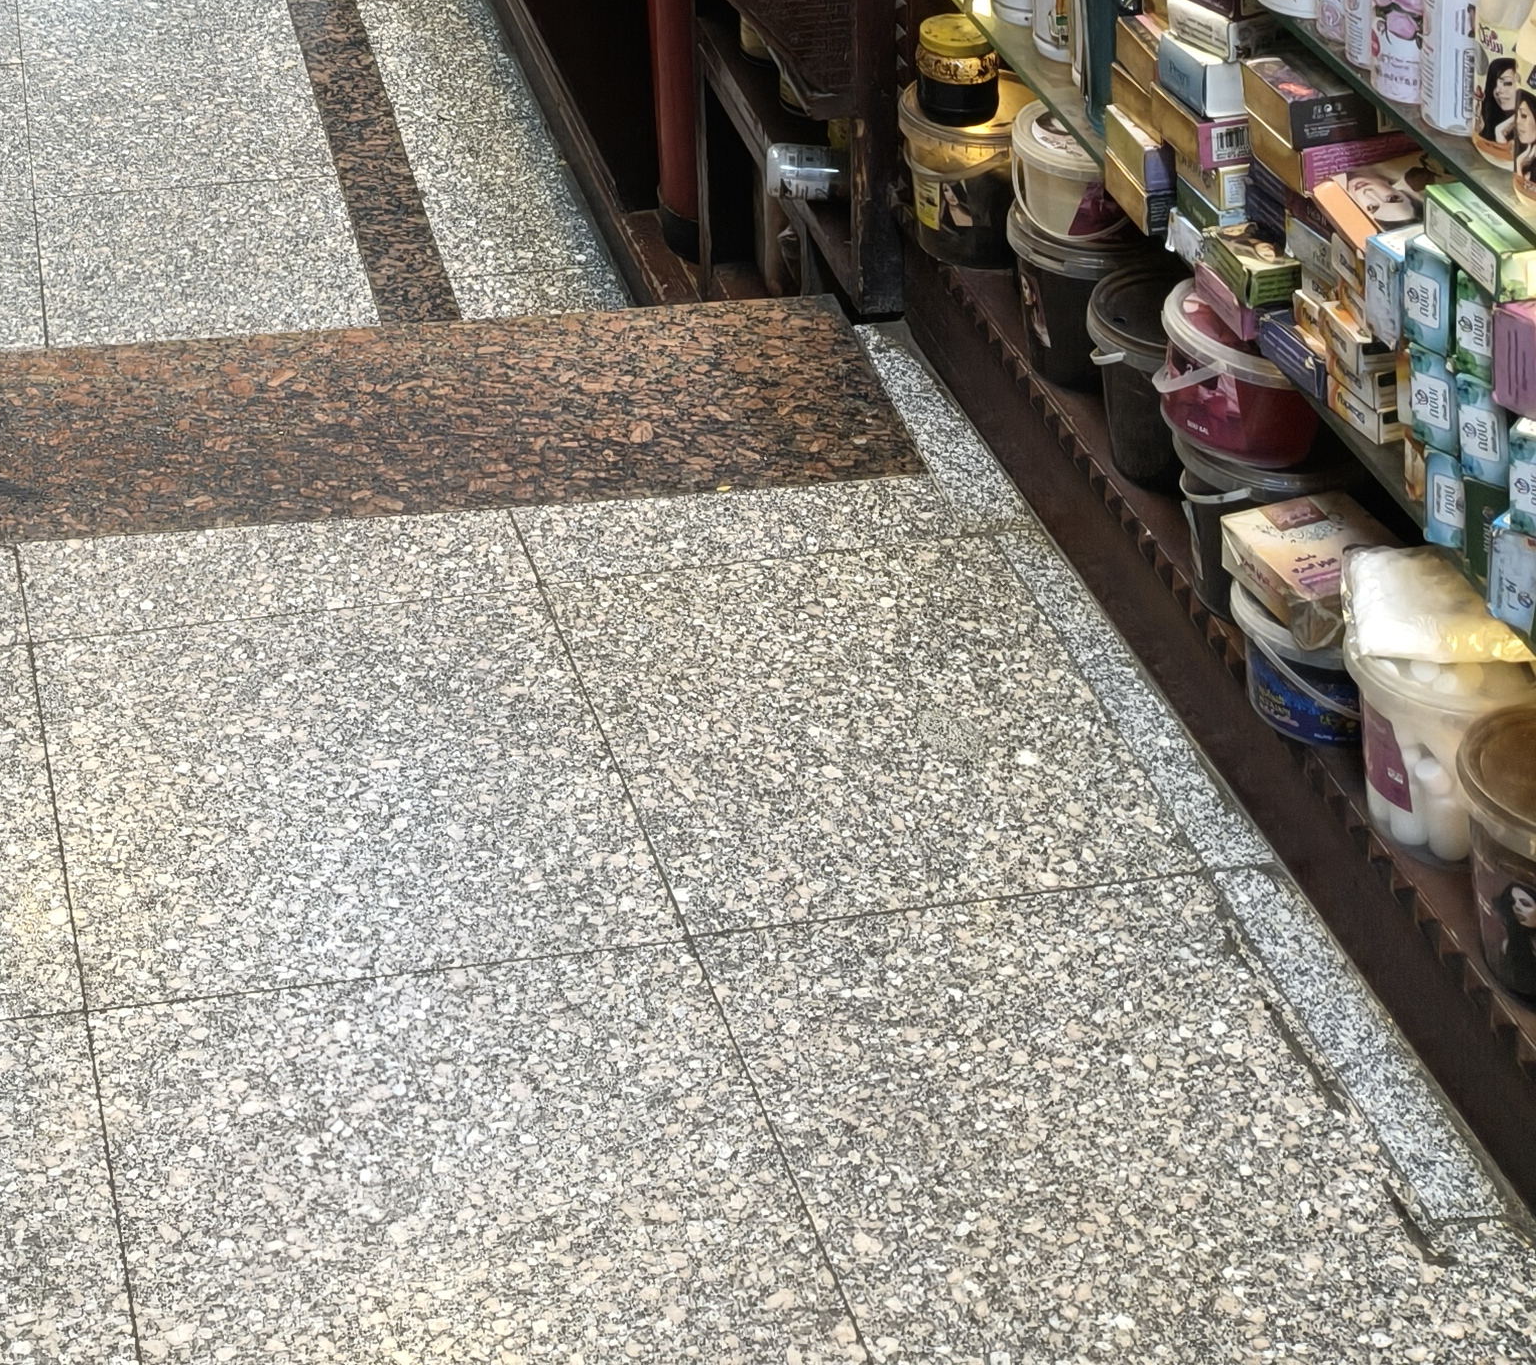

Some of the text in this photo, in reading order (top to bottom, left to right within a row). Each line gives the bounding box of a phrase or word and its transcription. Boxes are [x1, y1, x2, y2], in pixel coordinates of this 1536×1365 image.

[1420, 285, 1430, 318] nour
[1472, 315, 1486, 347] nour
[1429, 386, 1439, 419] nour
[1478, 418, 1488, 452] nour
[1444, 484, 1455, 518] nour
